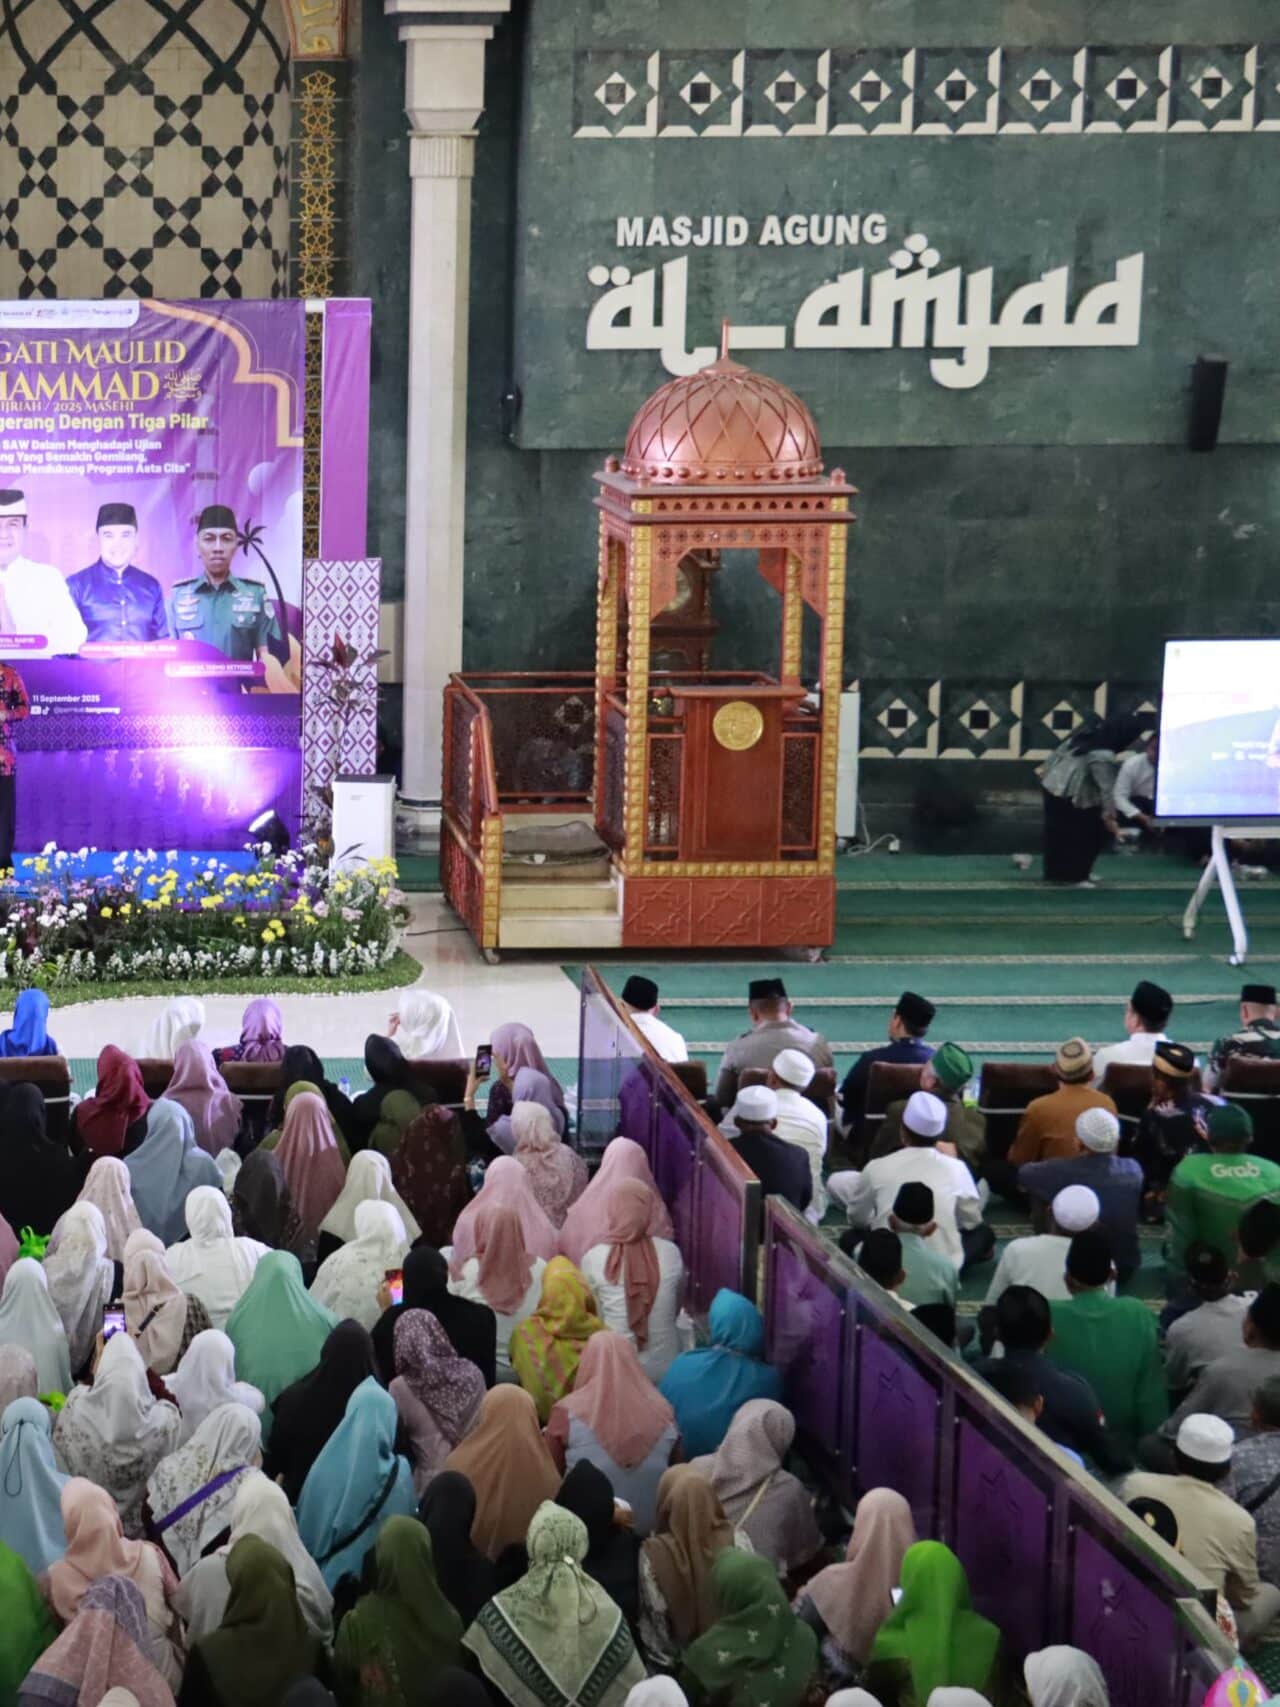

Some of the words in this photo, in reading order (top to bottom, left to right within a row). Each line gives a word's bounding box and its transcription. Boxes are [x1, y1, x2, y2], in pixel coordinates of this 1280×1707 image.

[616, 215, 749, 247] MASJID
[760, 213, 888, 246] AGUNG
[64, 338, 187, 369] MAULID
[54, 401, 82, 412] 2025
[85, 400, 135, 413] MASEHI
[59, 413, 124, 432] Dengan
[128, 413, 166, 432] Tiga
[170, 413, 209, 429] Pilar
[2, 439, 30, 450] SAW
[32, 439, 65, 450] Dalam
[134, 439, 162, 452] Ujian
[17, 451, 44, 464] Yang
[40, 694, 80, 703] September
[1211, 1161, 1261, 1178] Grab
